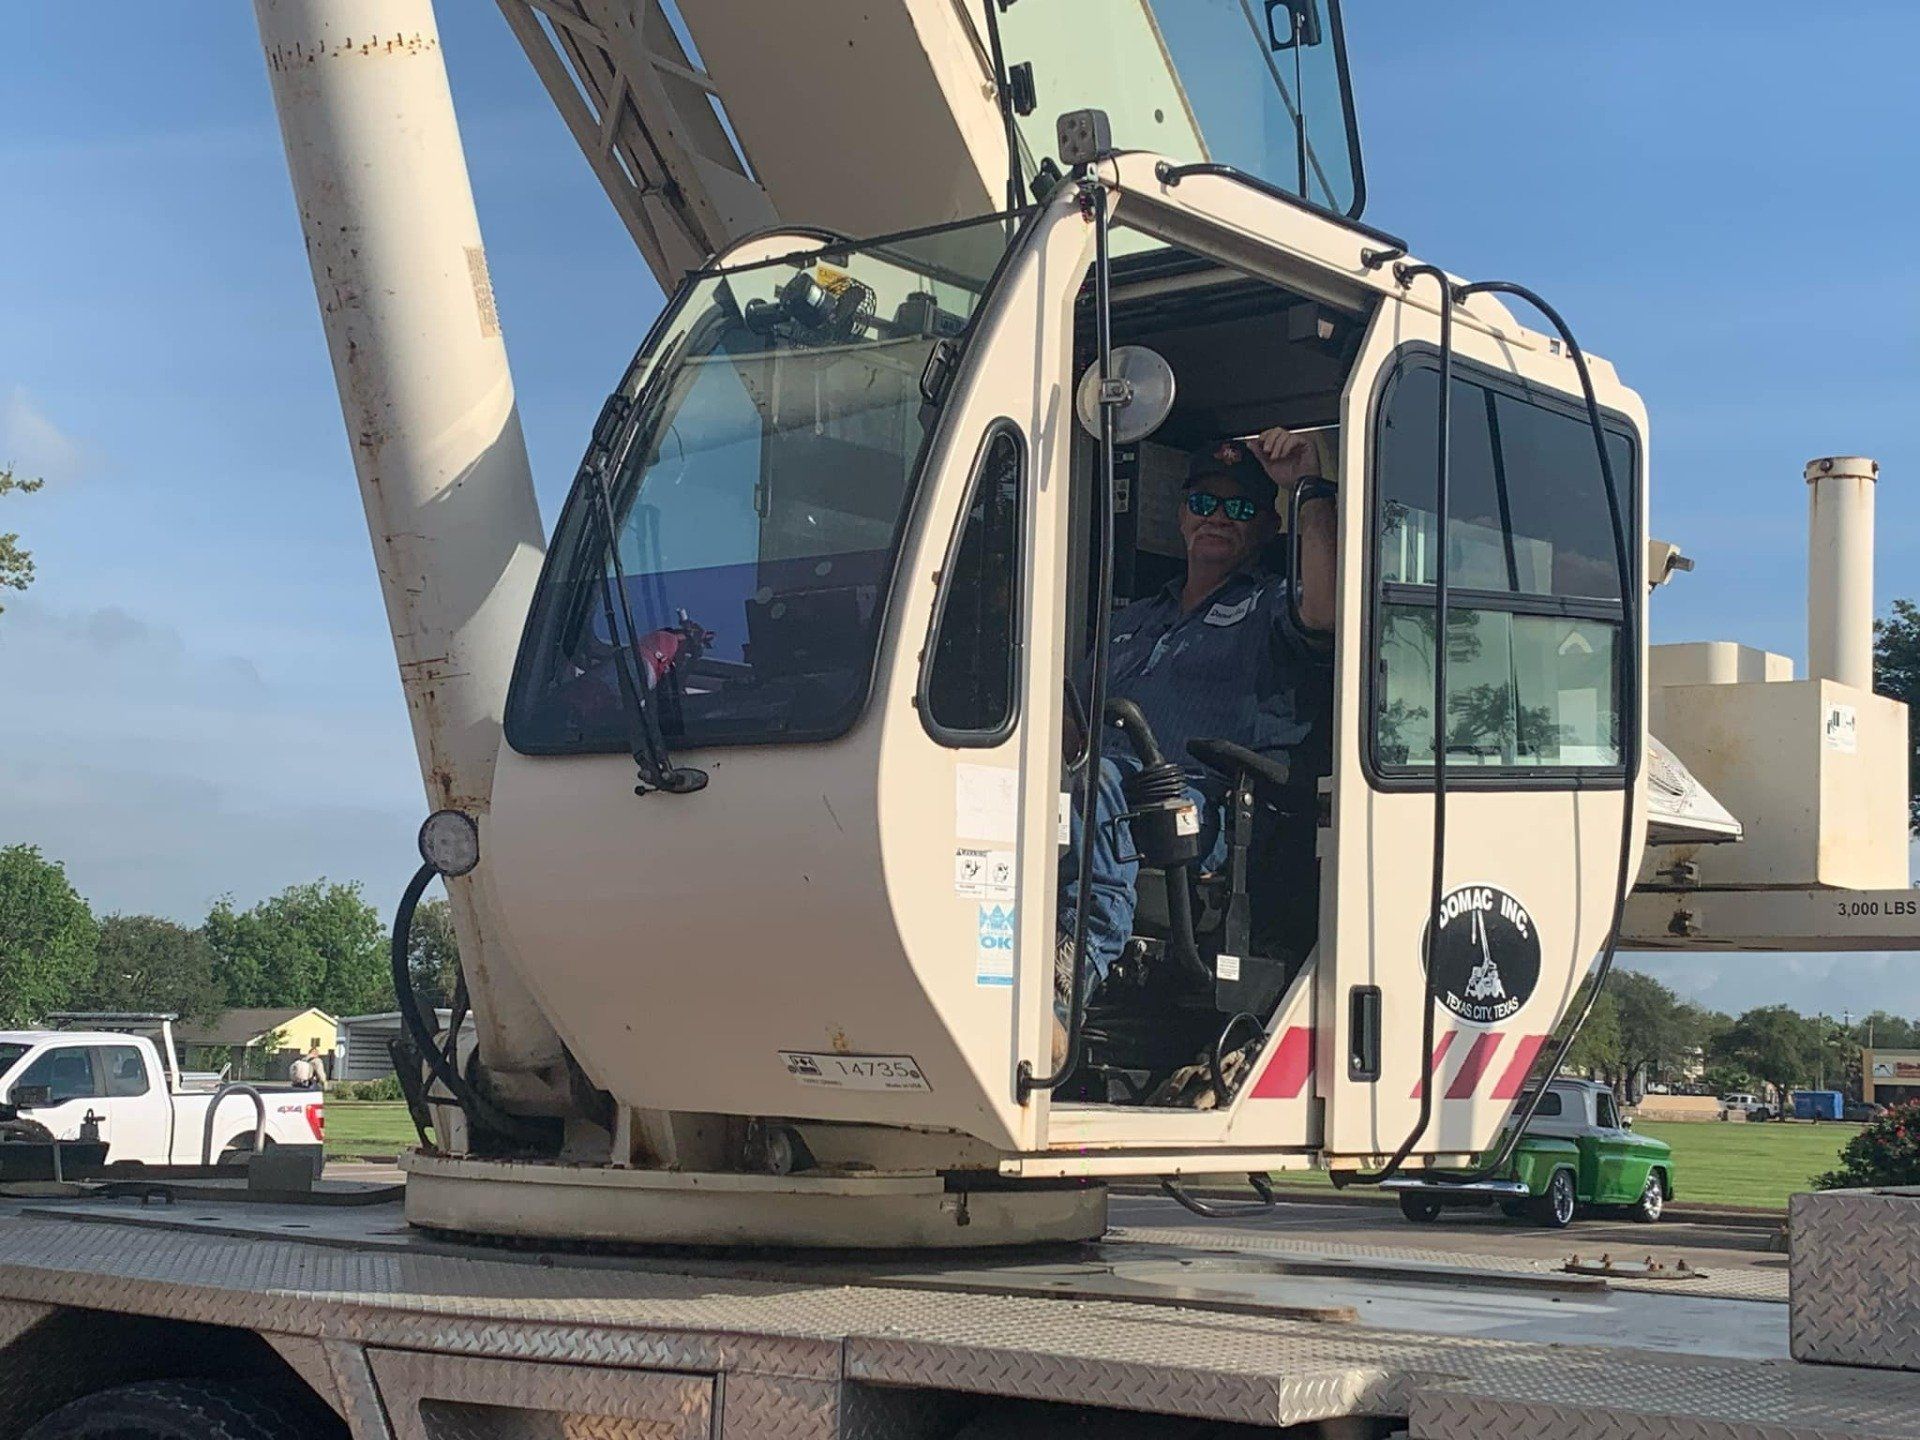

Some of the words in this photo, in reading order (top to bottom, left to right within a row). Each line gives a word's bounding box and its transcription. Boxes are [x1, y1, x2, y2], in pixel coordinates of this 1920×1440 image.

[1500, 894, 1529, 940] INC.
[1837, 901, 1879, 918] 3,000
[1884, 901, 1917, 915] LBS
[980, 935, 1012, 950] OK
[1446, 990, 1473, 1018] TEXAS
[1493, 995, 1520, 1018] TEXAS
[835, 1061, 909, 1078] 14735
